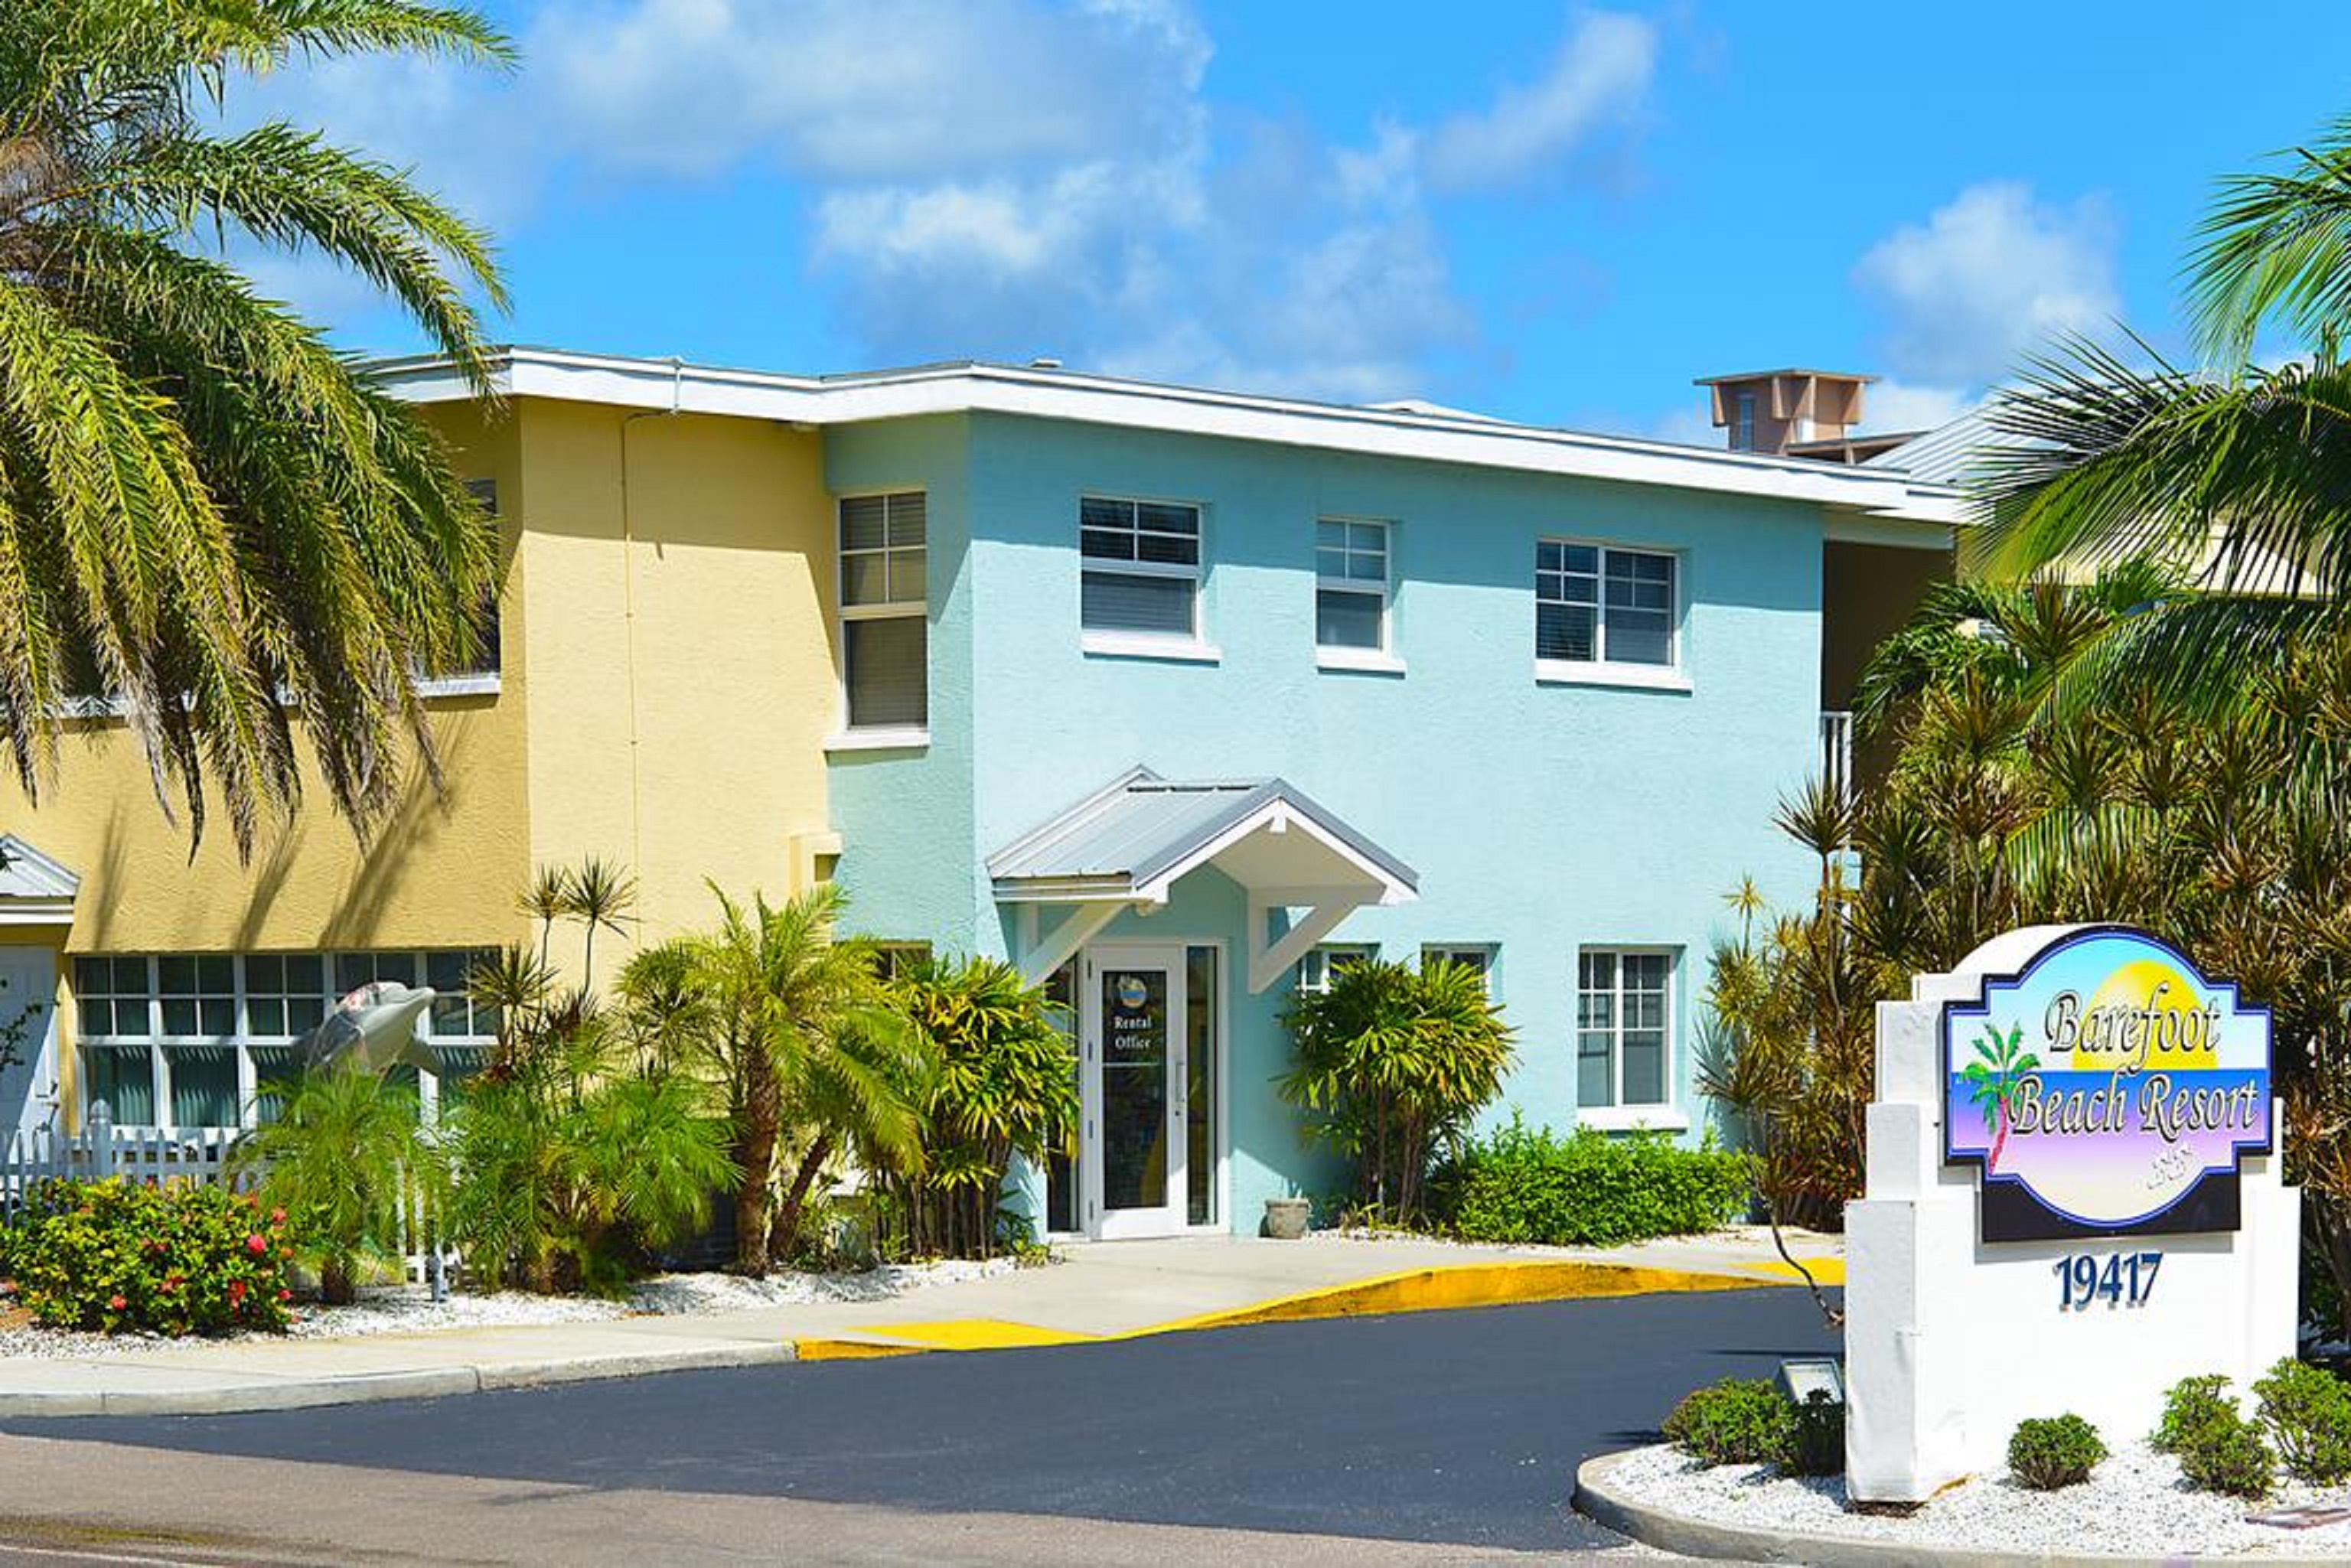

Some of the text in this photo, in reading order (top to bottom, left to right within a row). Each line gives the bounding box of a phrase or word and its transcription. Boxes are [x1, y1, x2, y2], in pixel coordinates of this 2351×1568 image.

[1114, 1015, 1152, 1029] Rental
[1115, 1035, 1151, 1049] Office
[2045, 981, 2221, 1074] Barefoot
[2007, 1064, 2258, 1143] Beach Resort
[2054, 1252, 2164, 1309] 19417
